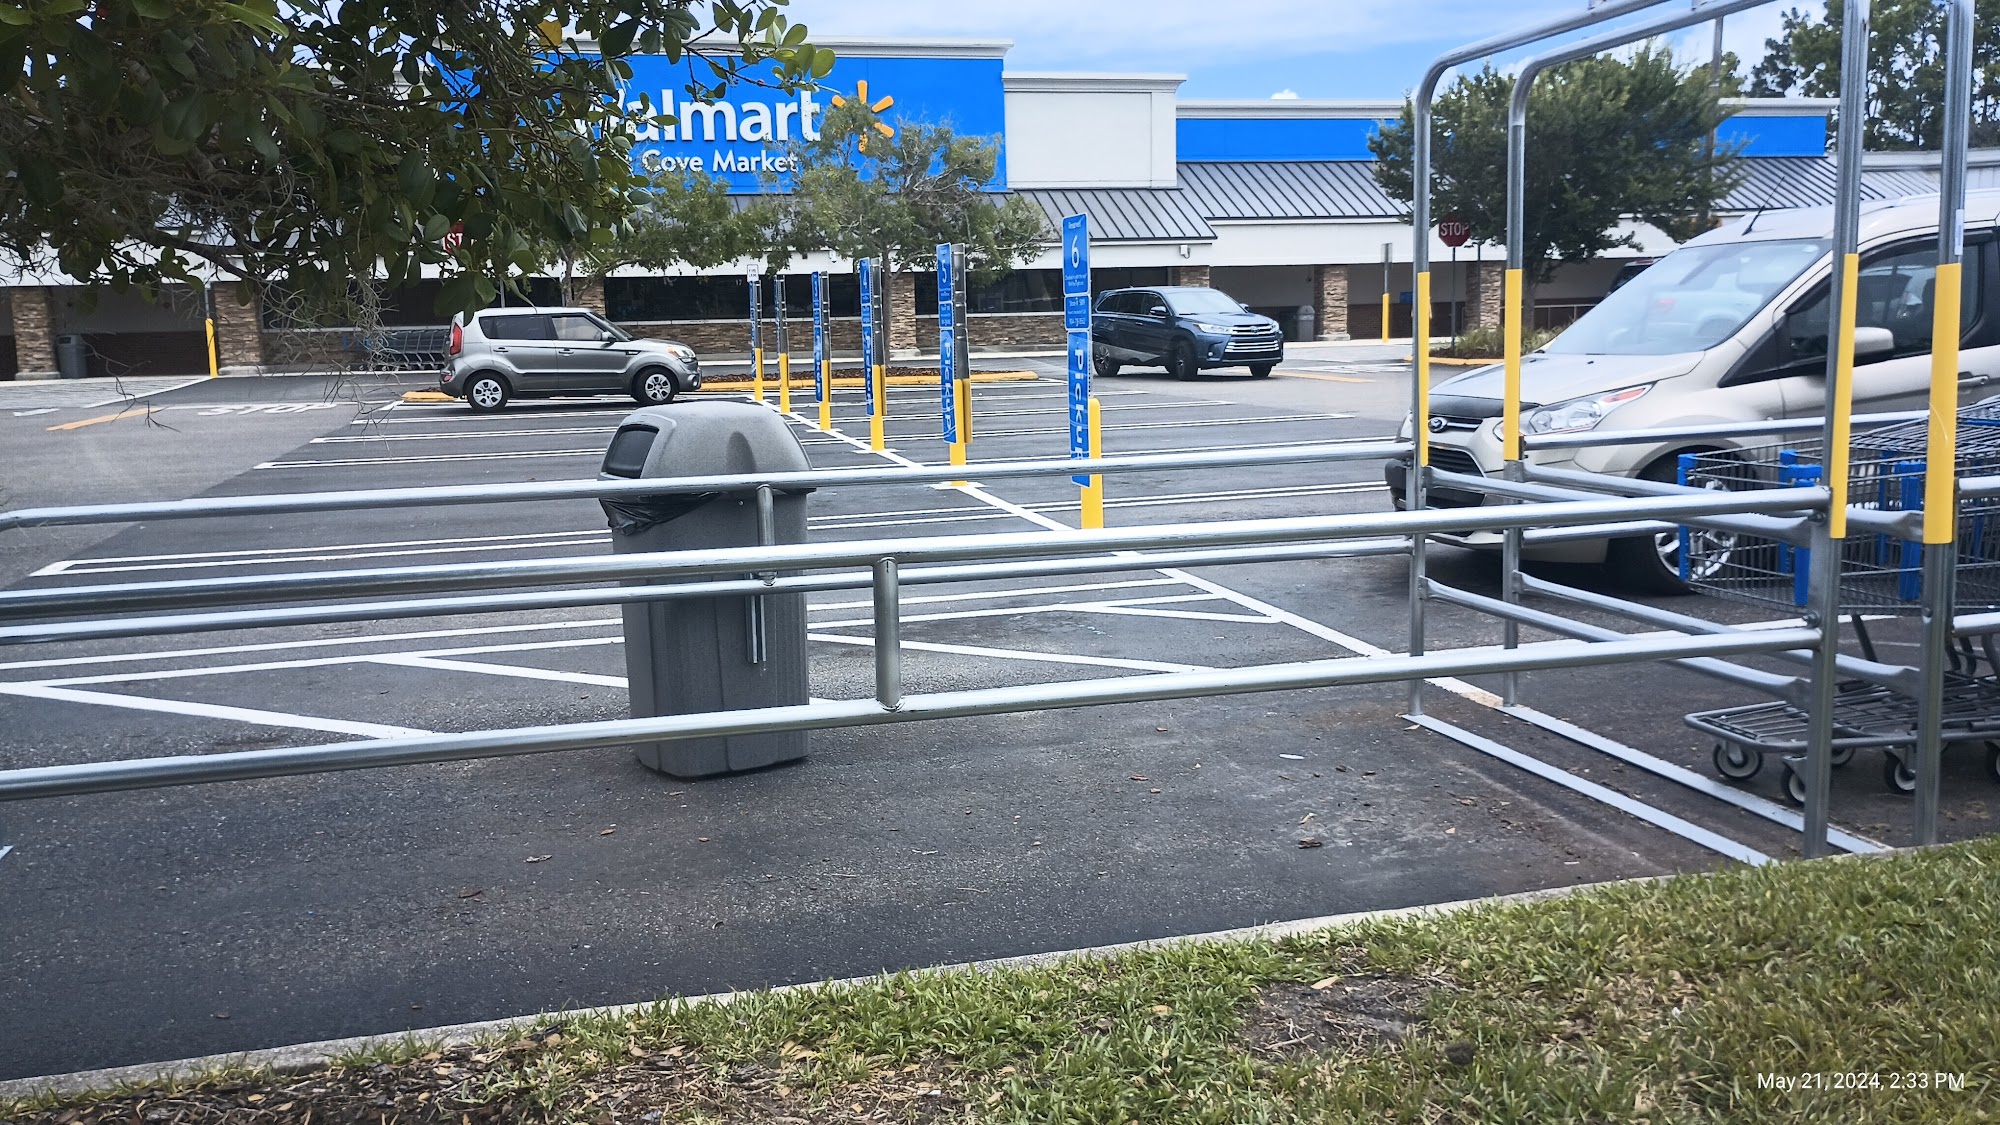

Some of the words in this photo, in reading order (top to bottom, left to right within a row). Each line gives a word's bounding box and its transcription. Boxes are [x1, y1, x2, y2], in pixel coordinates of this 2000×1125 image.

[642, 150, 704, 173] Cove
[712, 149, 798, 173] Market
[1440, 222, 1469, 236] STOP
[1071, 235, 1080, 268] 6
[942, 259, 948, 283] 5
[944, 342, 952, 432] Pickup
[197, 403, 337, 416] STOP
